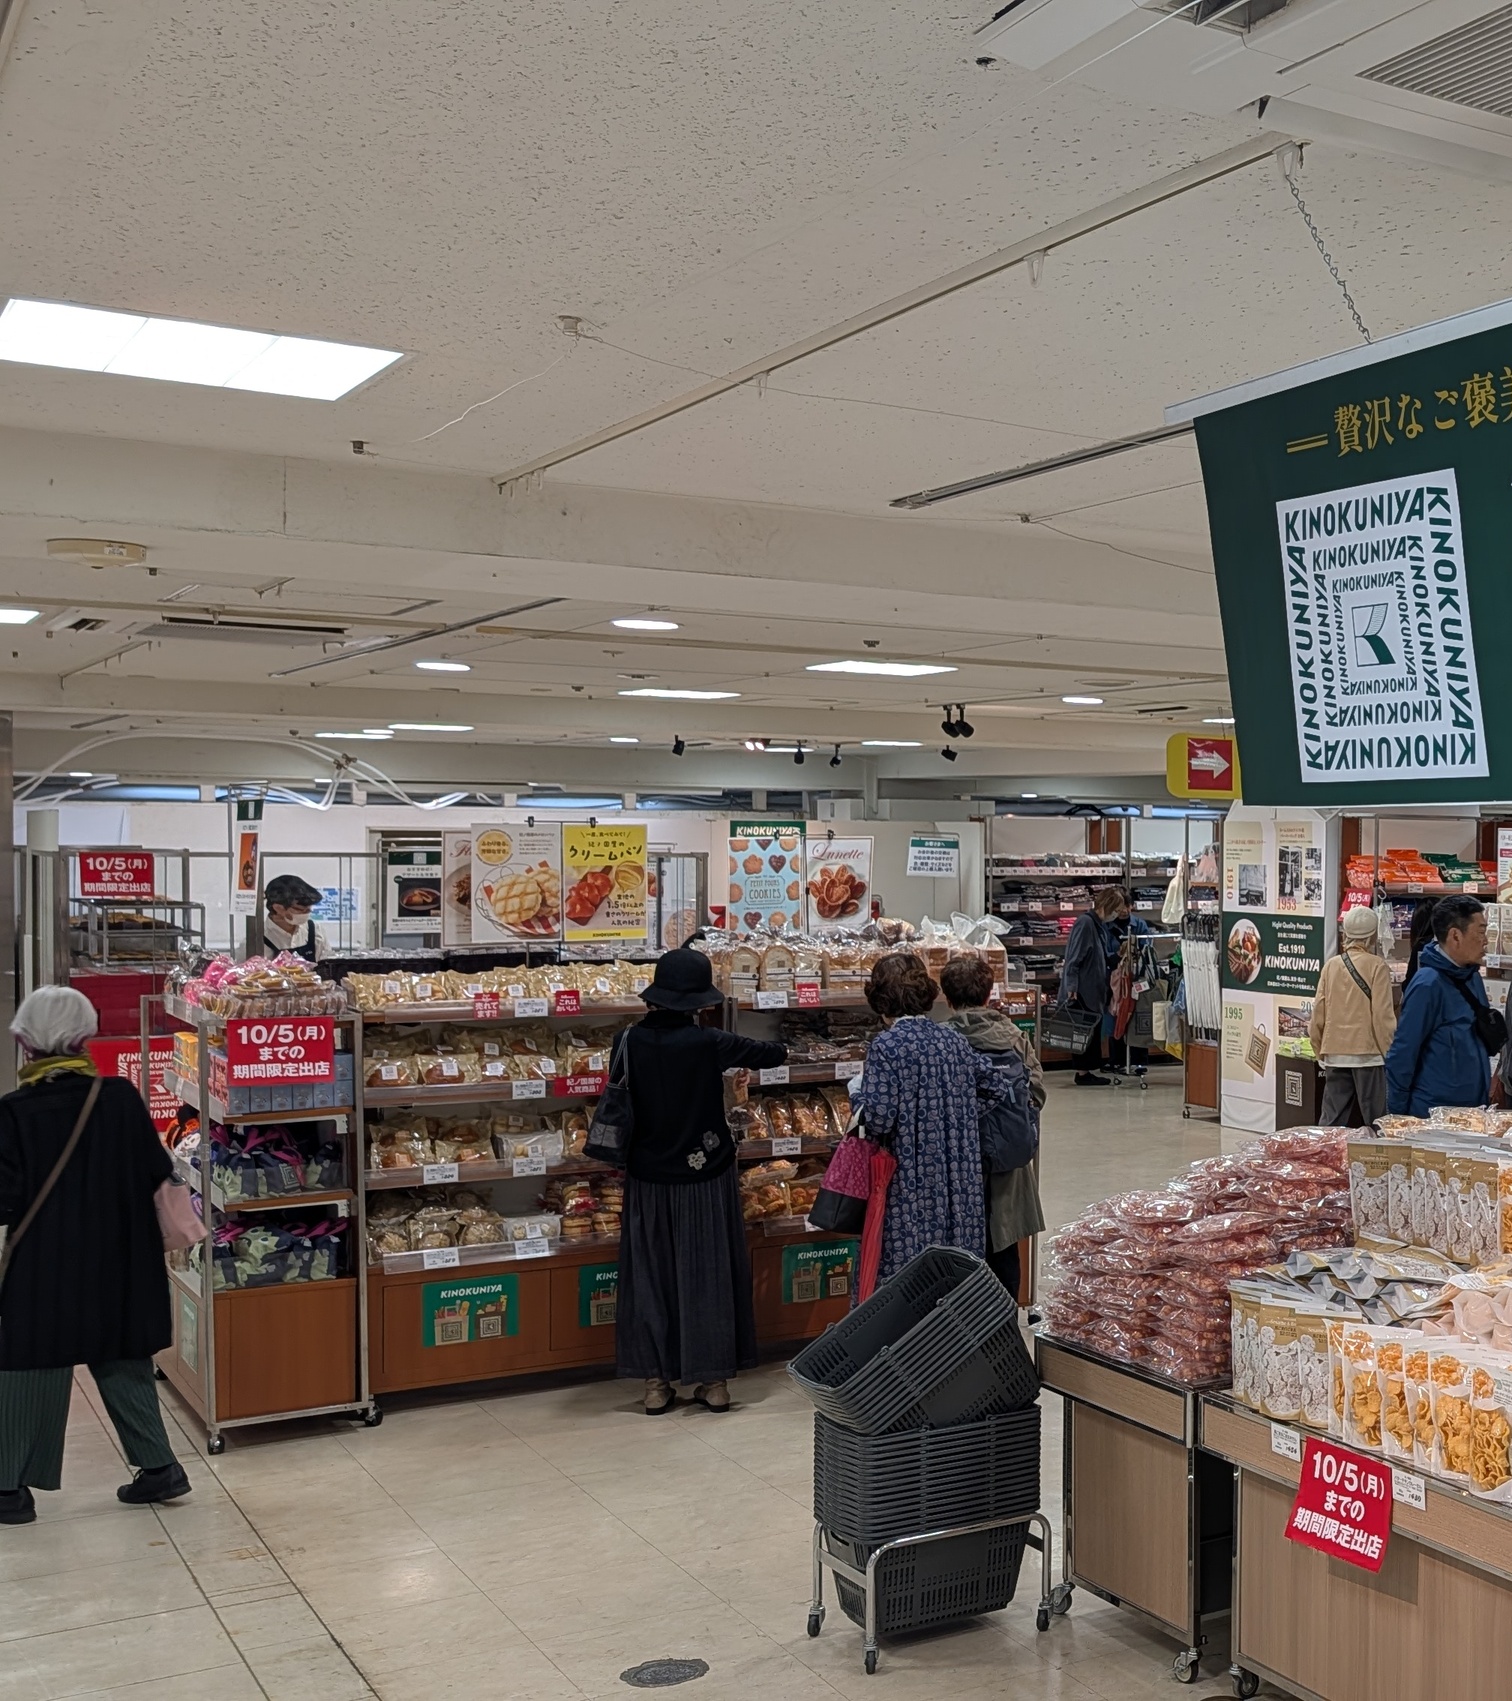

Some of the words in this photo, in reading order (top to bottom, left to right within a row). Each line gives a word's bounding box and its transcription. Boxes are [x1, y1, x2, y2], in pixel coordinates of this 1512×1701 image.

[1285, 487, 1425, 543] KINOKUNIYA
[1313, 535, 1407, 572] KINOKUNIYA
[1407, 535, 1441, 697] KINOKUNIYA
[1427, 487, 1475, 730] KINOKUNIYA
[1287, 544, 1323, 770] KINOKUNIYA
[1314, 573, 1339, 727] KINOKUNIYA
[1339, 699, 1442, 727] KINOKUNIYA
[1324, 733, 1476, 770] KINOKUNIYA
[570, 845, 642, 861] クリームパン
[812, 842, 864, 861] Lunette
[102, 872, 134, 881] までの
[84, 883, 151, 893] 期間限定出店
[749, 888, 781, 900] COOKIES
[1277, 898, 1297, 911] 1953
[1265, 955, 1320, 972] KINOKUNIYA
[1224, 1007, 1242, 1020] 1995
[238, 1025, 325, 1044] 10/5(月)
[259, 1046, 305, 1060] までの
[233, 1062, 330, 1079] 期間限定出店
[797, 1248, 848, 1260] KINOKUNIYA
[440, 1284, 502, 1298] KINOKUNIYA
[1313, 1451, 1385, 1500] 10/5(月)
[1324, 1490, 1365, 1522] までの
[1293, 1507, 1384, 1559] 期間限定出店
